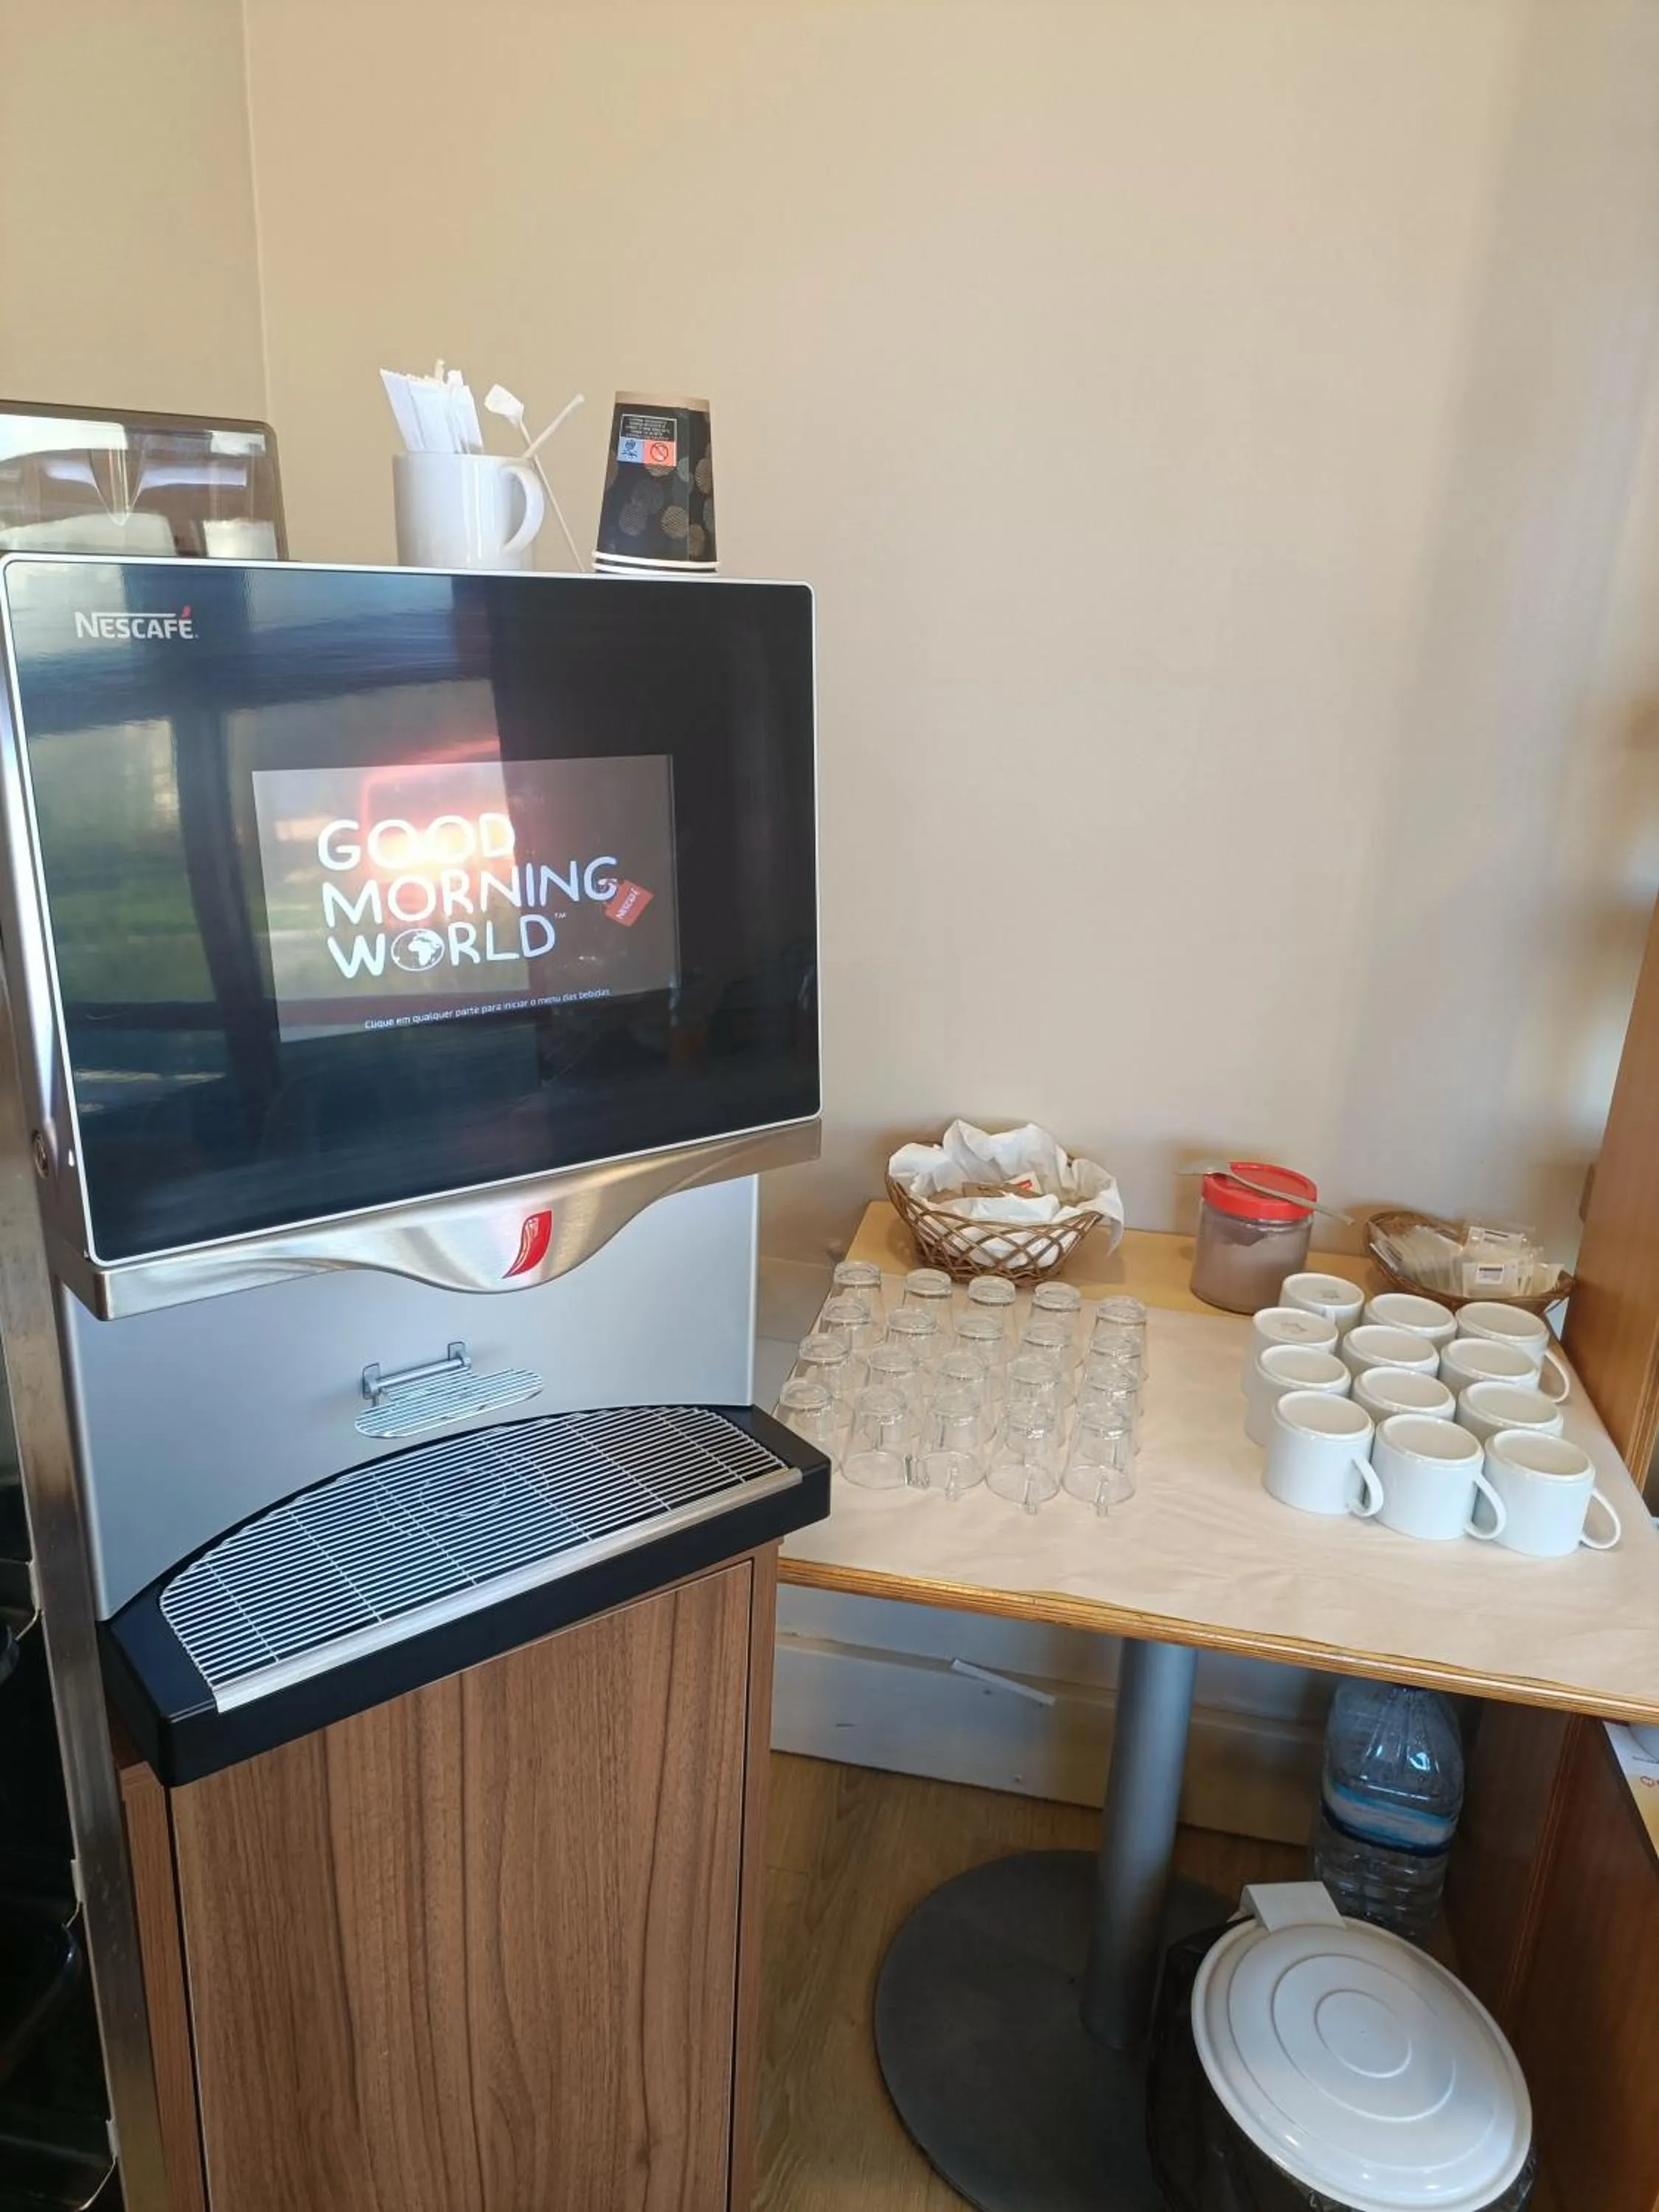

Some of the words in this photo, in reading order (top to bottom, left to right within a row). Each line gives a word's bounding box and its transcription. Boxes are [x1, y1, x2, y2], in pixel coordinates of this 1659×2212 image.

[74, 605, 195, 639] NESCAFÉ
[318, 813, 515, 871] GOOD
[322, 856, 618, 928] MORNING
[396, 1017, 411, 1026] em
[412, 1010, 453, 1023] qualquer
[455, 1006, 480, 1018] parte
[481, 1004, 502, 1015] para
[503, 999, 528, 1011] iniciar
[538, 995, 561, 1006] menu
